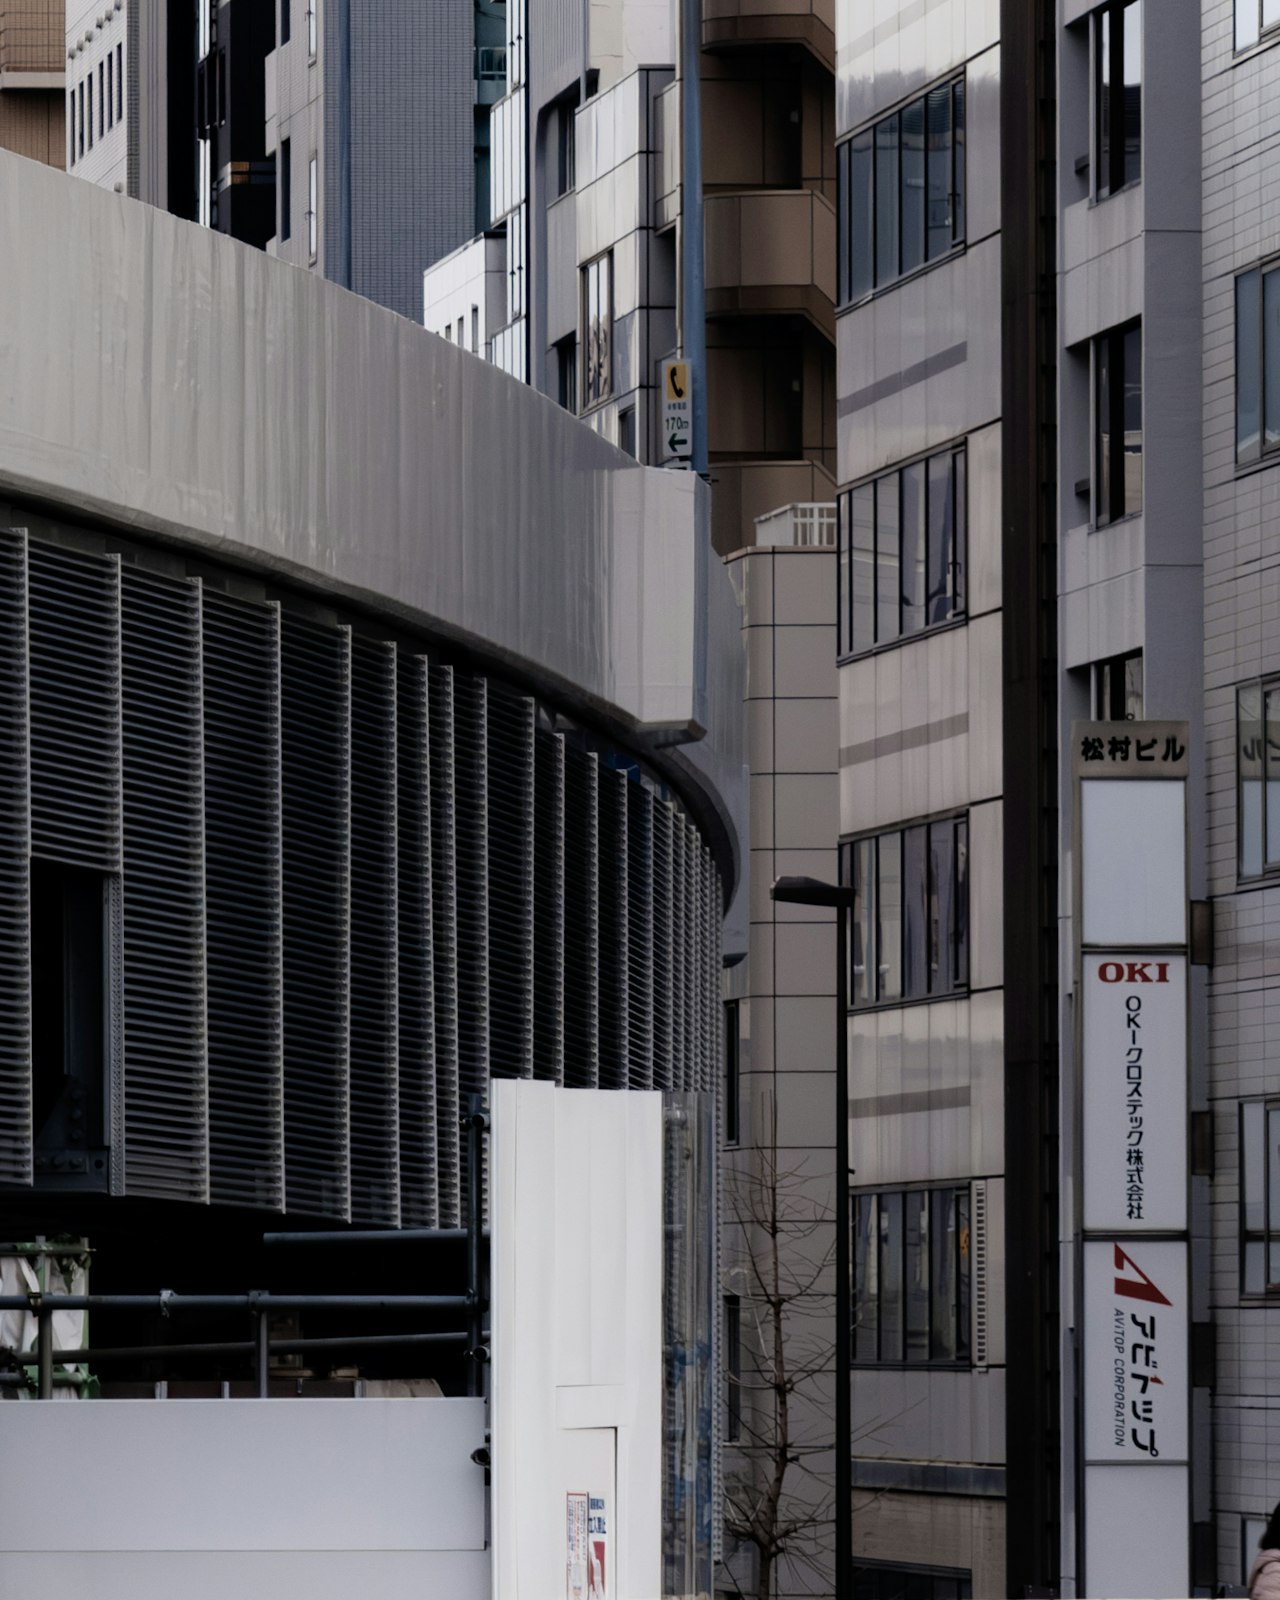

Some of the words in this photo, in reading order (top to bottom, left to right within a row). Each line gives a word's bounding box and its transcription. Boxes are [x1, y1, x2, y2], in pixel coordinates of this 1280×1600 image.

[1081, 736, 1186, 761] 松村ビル
[1098, 962, 1170, 983] OKI
[1113, 1308, 1125, 1354] AVITOP
[1113, 1358, 1126, 1447] CORPORATION
[1131, 1313, 1160, 1457] アビトップ
